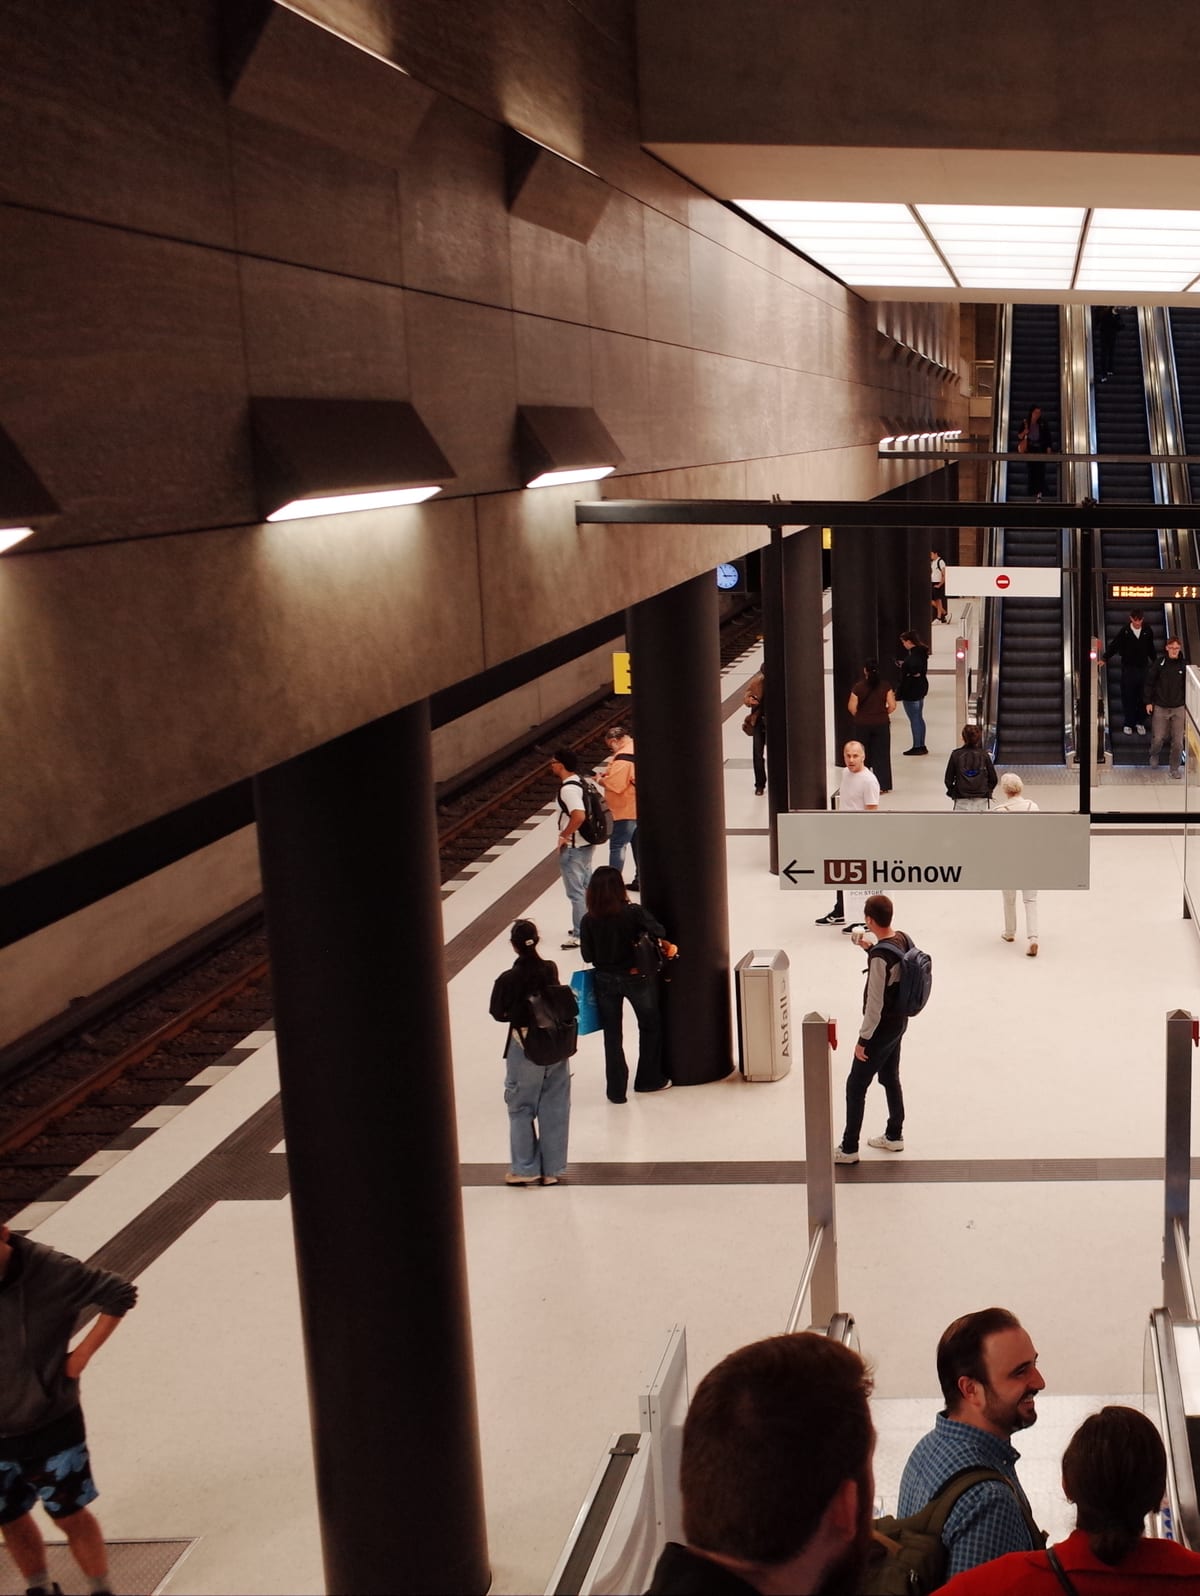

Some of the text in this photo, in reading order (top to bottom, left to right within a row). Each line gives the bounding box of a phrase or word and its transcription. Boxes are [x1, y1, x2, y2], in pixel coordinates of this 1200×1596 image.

[828, 860, 962, 882] U5 Hönow
[779, 996, 790, 1057] Abfall
